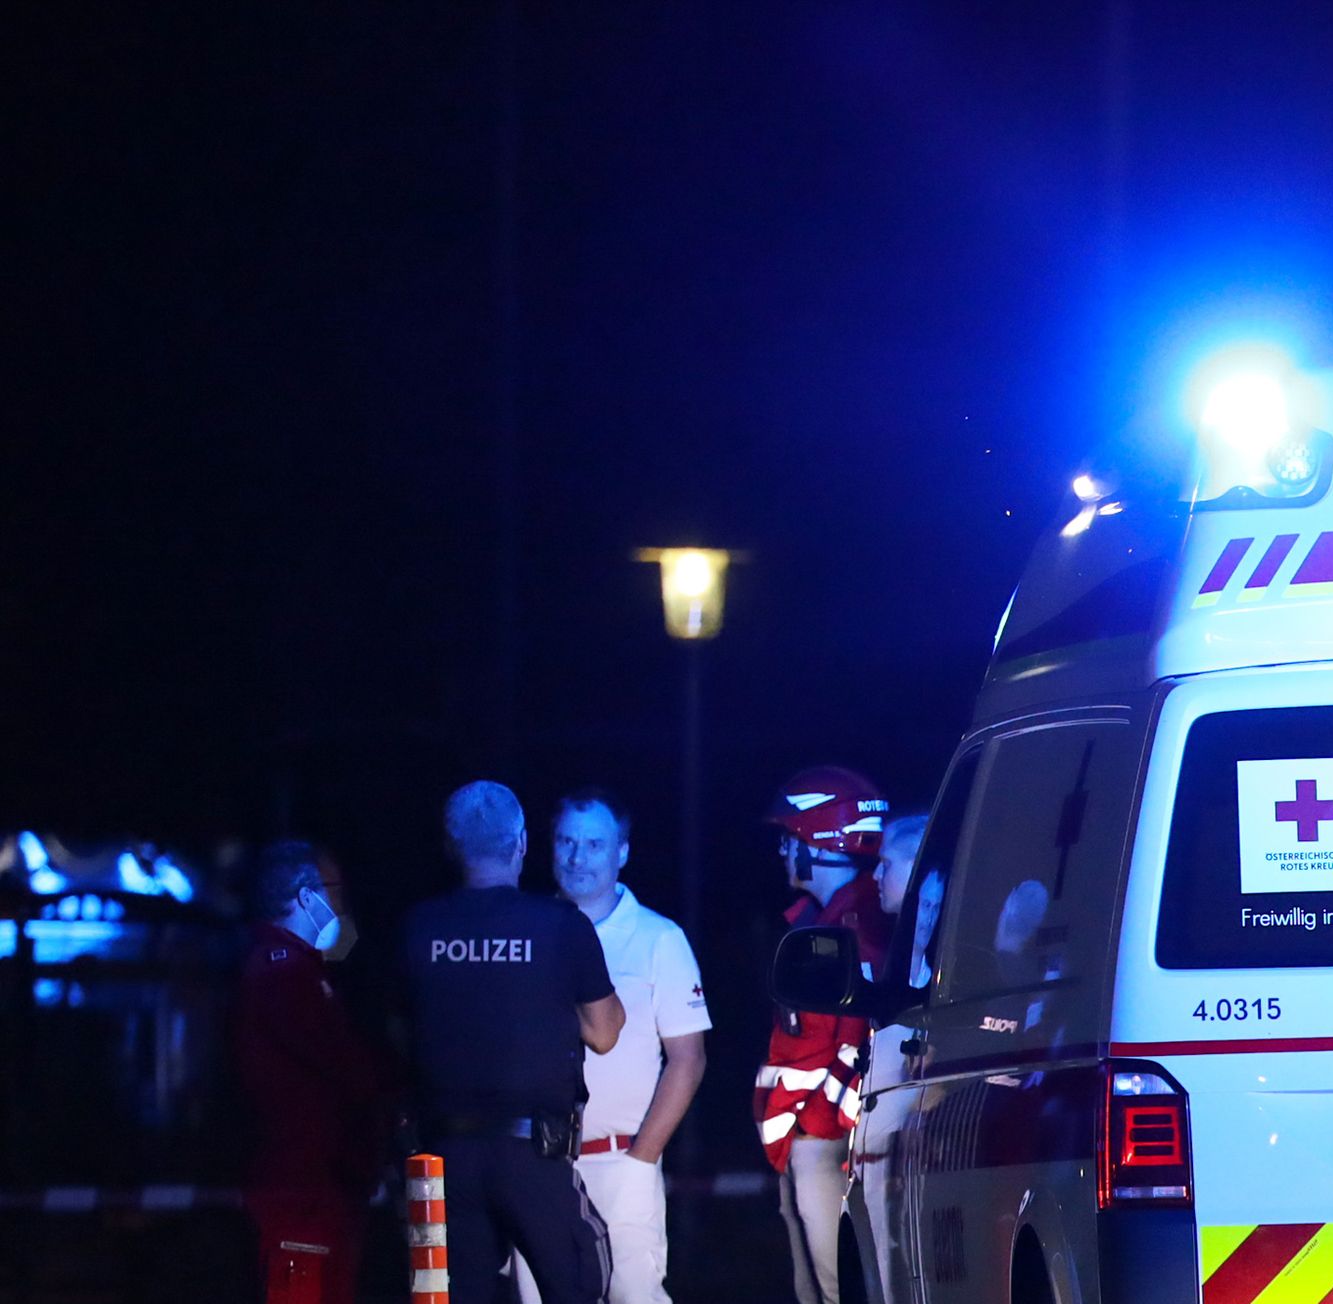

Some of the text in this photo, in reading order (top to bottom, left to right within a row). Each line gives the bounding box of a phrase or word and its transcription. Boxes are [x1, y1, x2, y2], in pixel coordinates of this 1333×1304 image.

[1280, 863, 1309, 871] ROTES
[1241, 908, 1317, 930] Freiwillig
[431, 939, 532, 962] POLIZEI
[1192, 997, 1281, 1021] 4.0315
